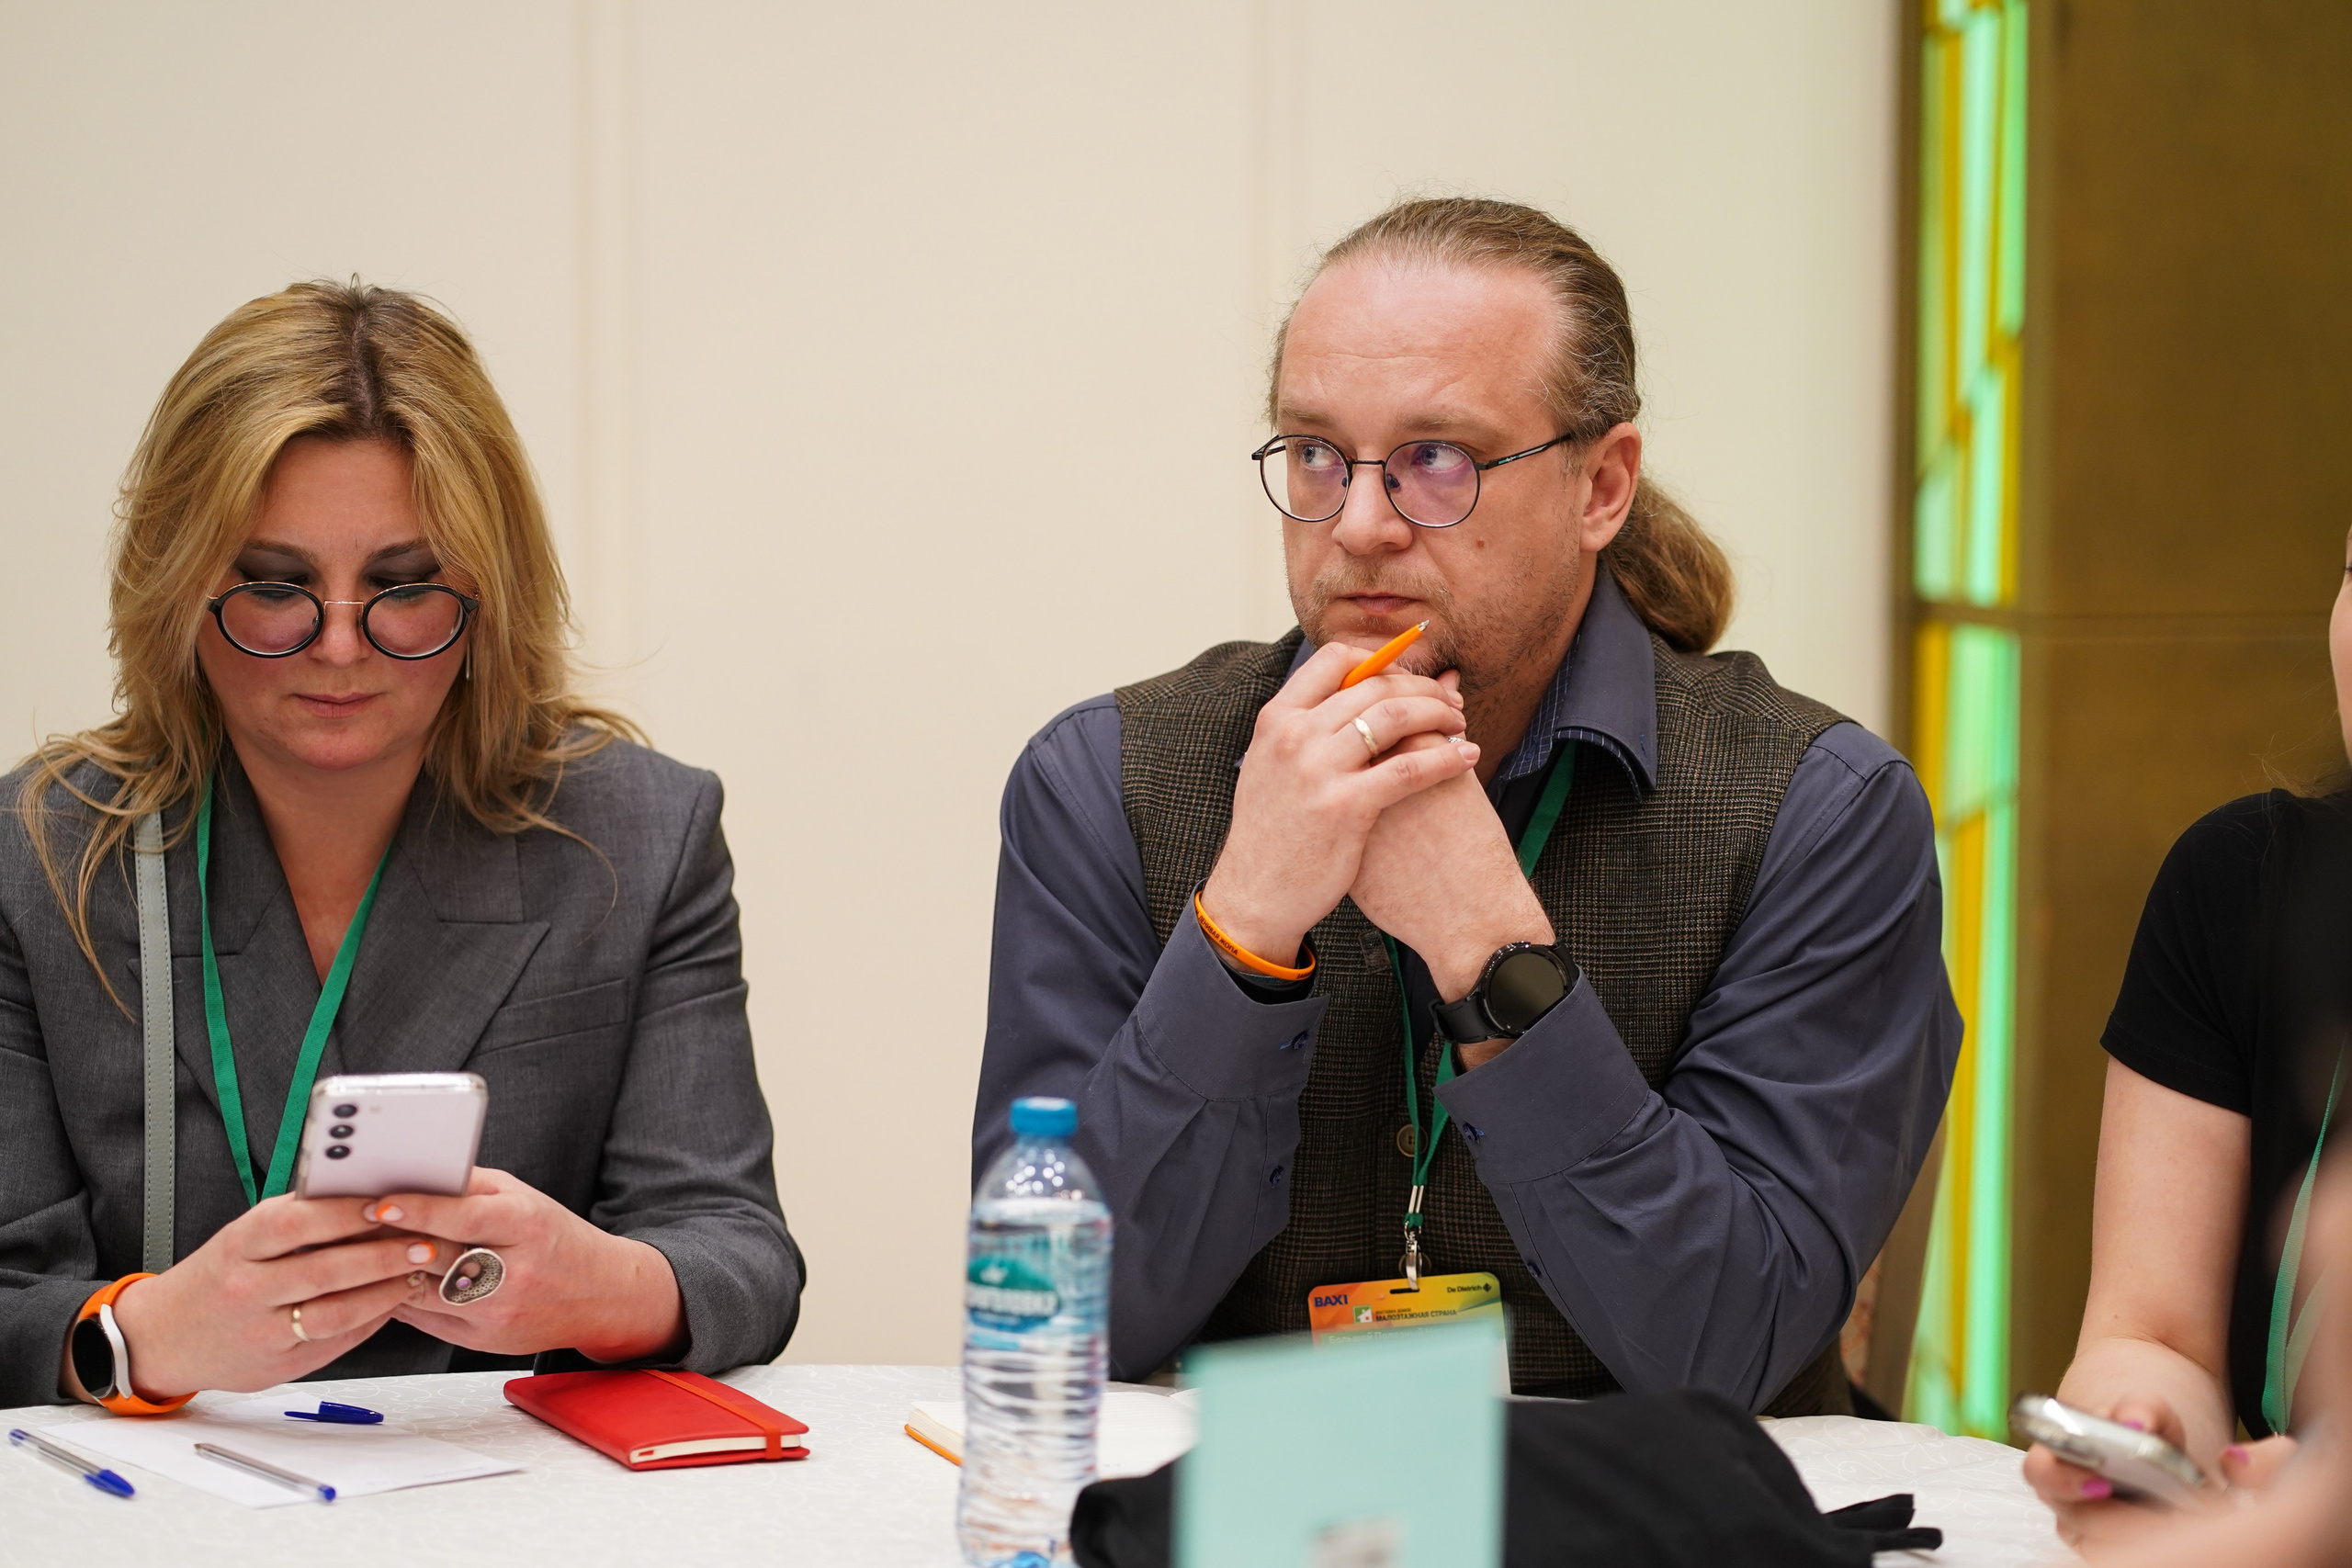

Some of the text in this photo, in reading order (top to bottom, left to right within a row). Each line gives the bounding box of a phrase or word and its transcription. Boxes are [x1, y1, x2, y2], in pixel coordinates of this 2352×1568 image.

[1198, 915, 1238, 955] ЛЕНИВАЯ ЖОПА
[1314, 1294, 1348, 1308] BAXI
[1376, 1309, 1457, 1321] МАЛОЭТАЖНАЯ СТРАНА
